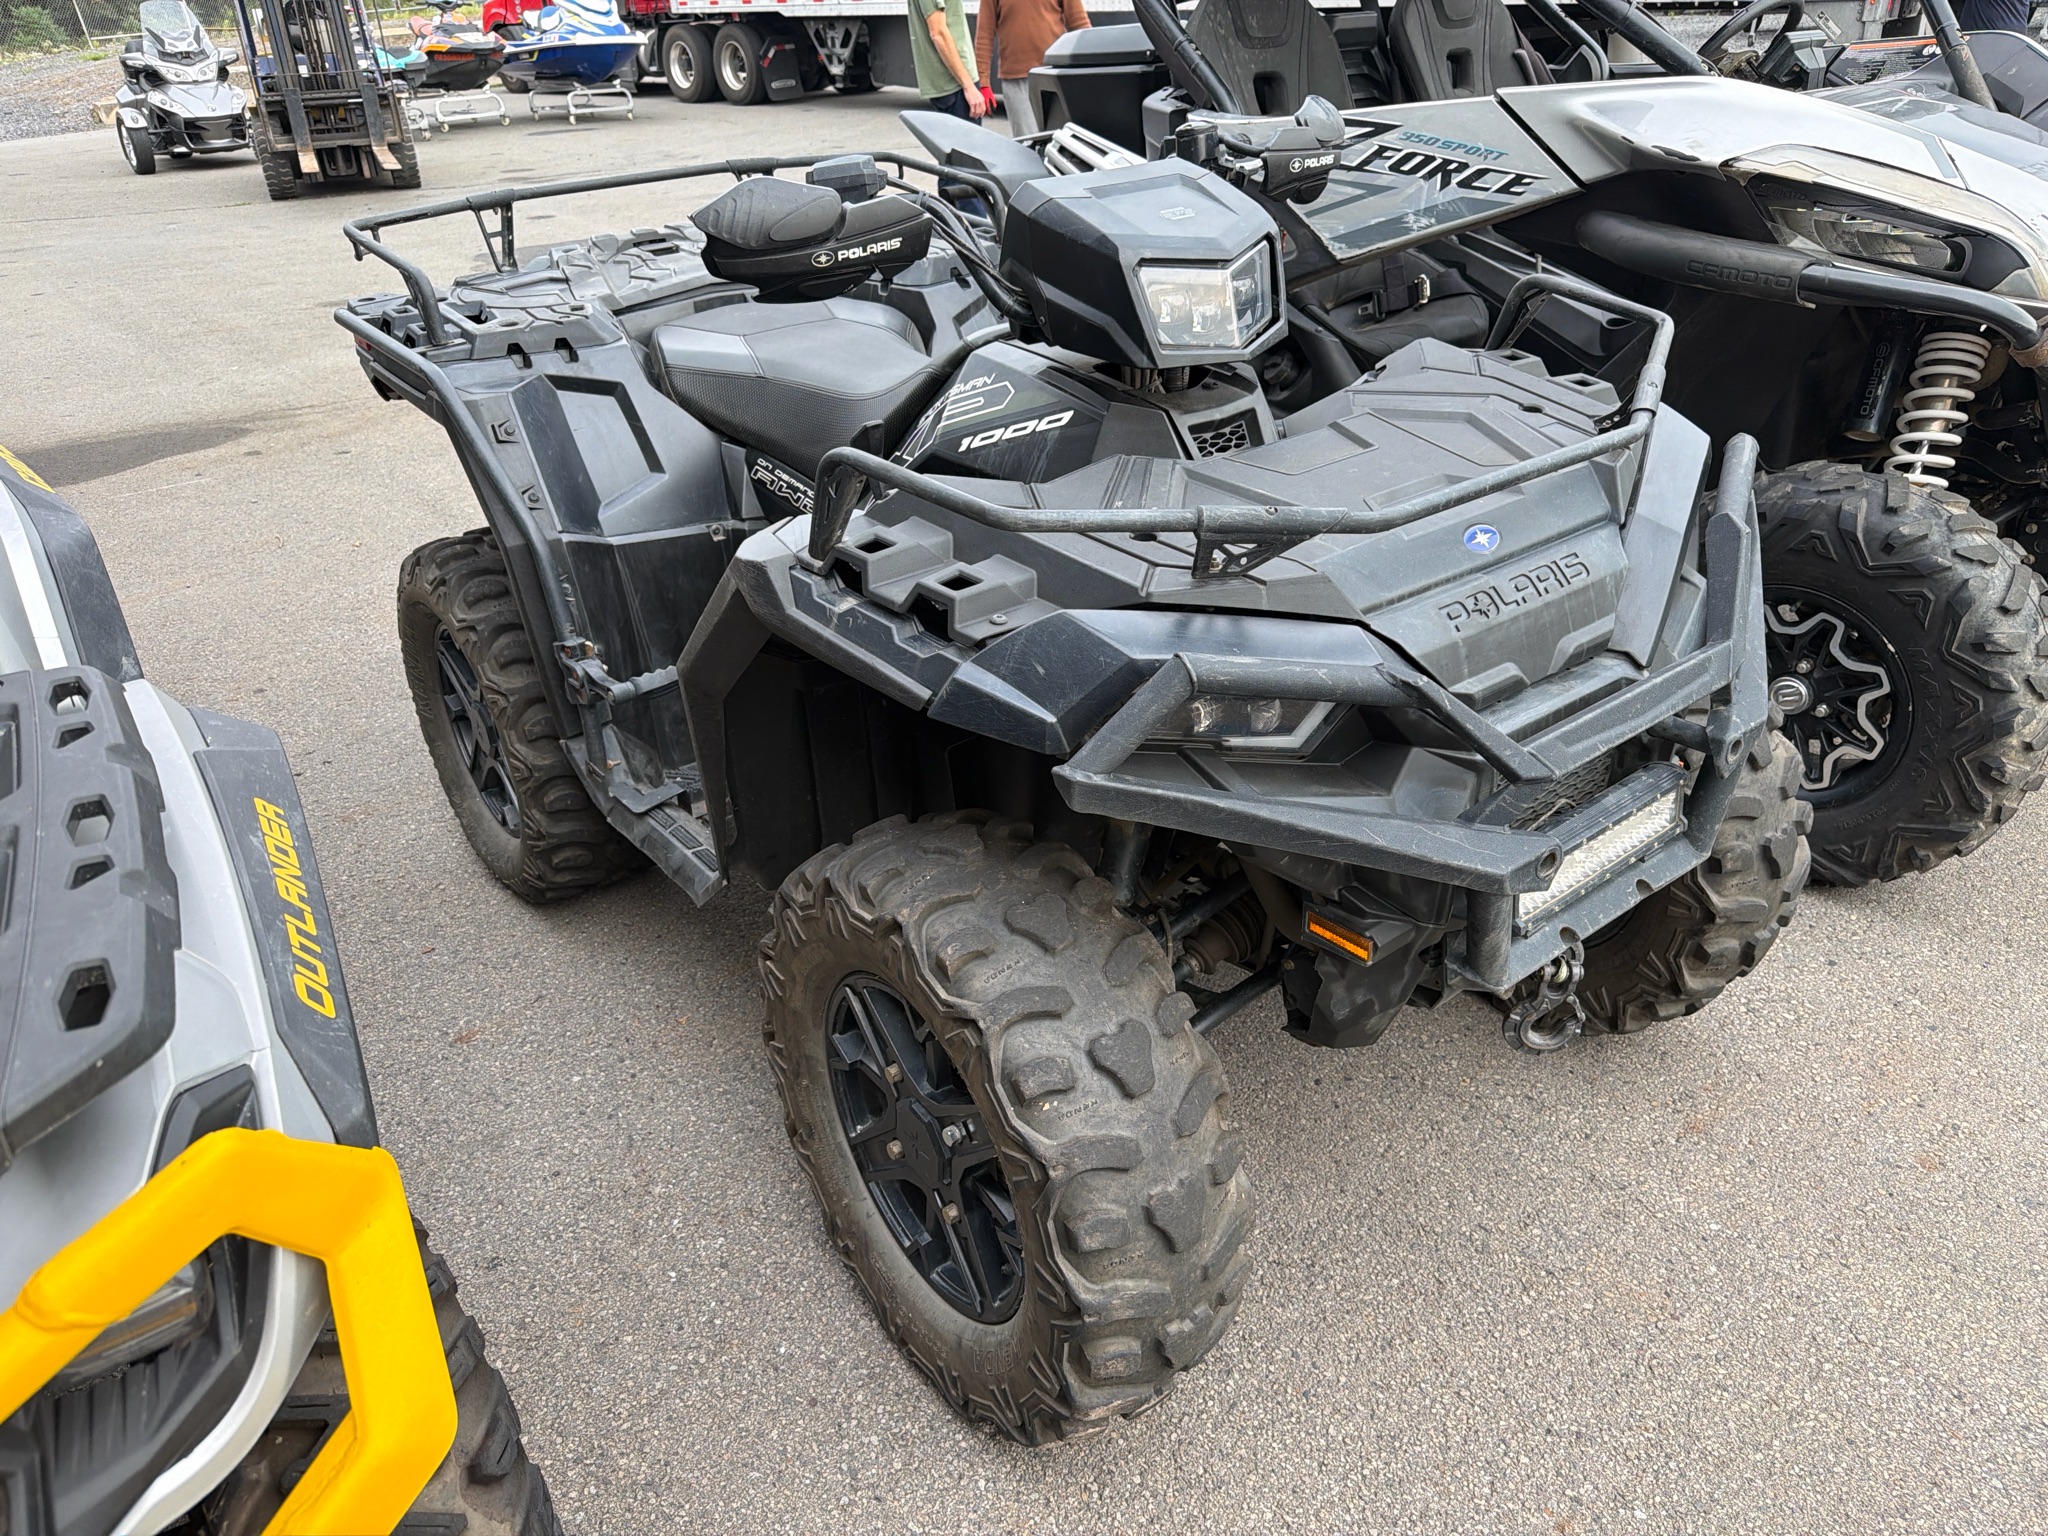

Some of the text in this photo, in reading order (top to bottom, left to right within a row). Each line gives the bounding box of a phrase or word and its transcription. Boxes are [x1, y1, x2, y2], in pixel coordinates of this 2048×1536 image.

[1304, 154, 1335, 169] POLARIS
[1398, 131, 1508, 162] 950 SPORT
[838, 237, 902, 261] POLARIS
[1685, 259, 1793, 289] CFMOTO
[1860, 358, 1884, 416] CFMOTO
[958, 409, 1074, 453] 1000
[1438, 551, 1591, 634] POLARIS
[253, 796, 337, 1020] OUTLANDER
